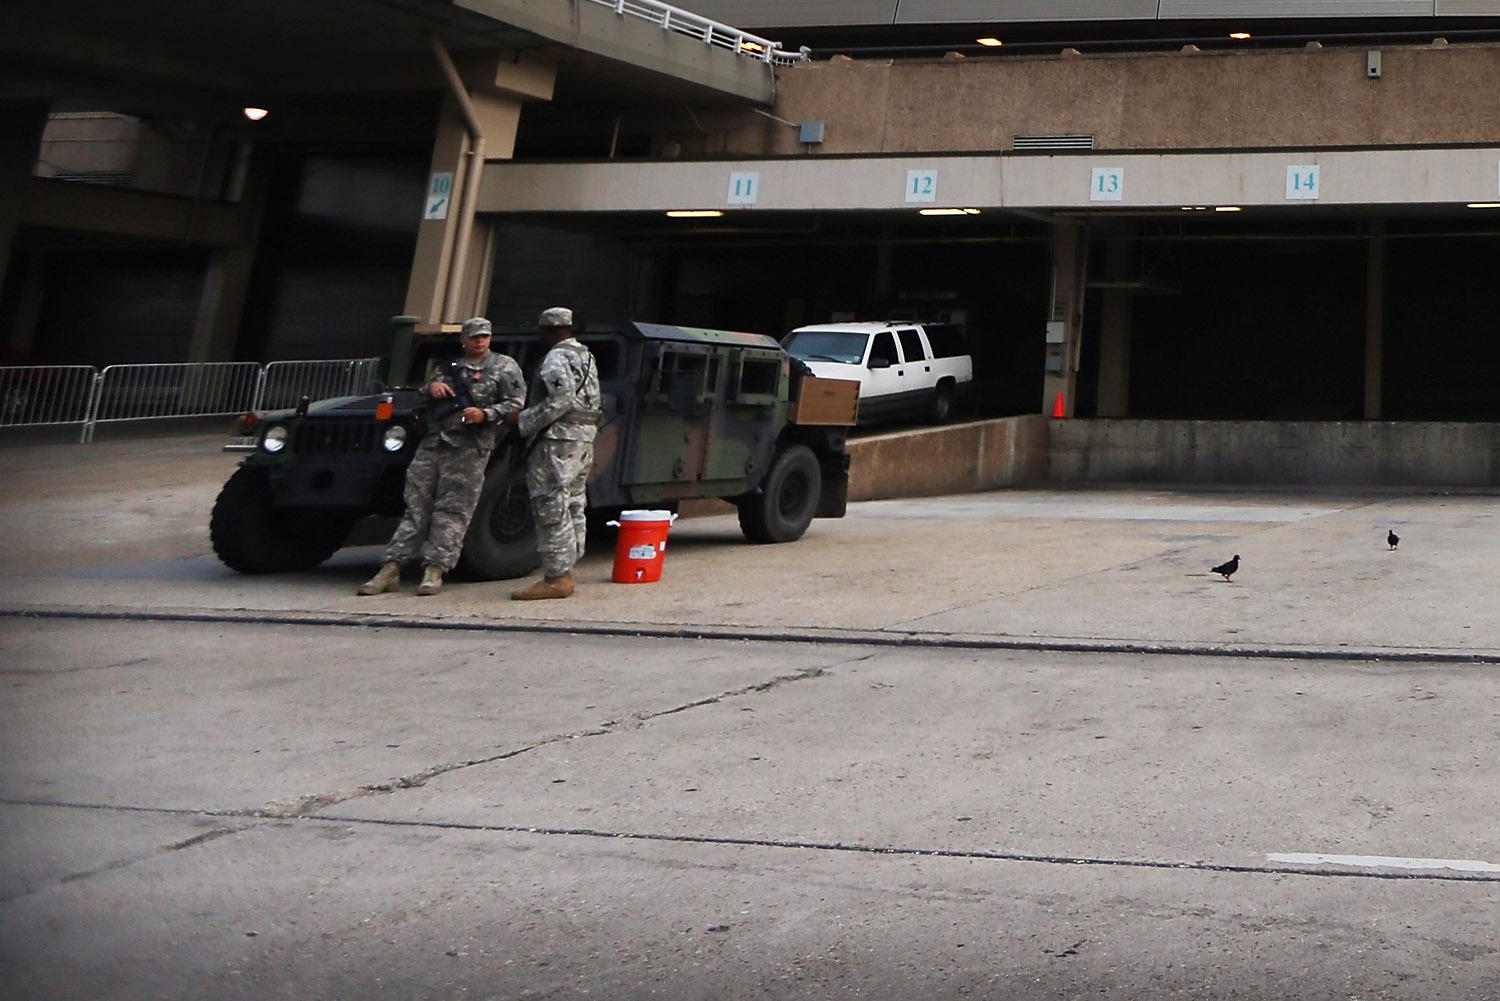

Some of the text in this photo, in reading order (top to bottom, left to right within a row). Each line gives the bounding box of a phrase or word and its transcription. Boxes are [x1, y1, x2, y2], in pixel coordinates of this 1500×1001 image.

[433, 178, 450, 194] 10
[735, 178, 752, 196] 11
[912, 176, 932, 194] 12
[1097, 174, 1118, 192] 13
[1293, 172, 1315, 190] 14
